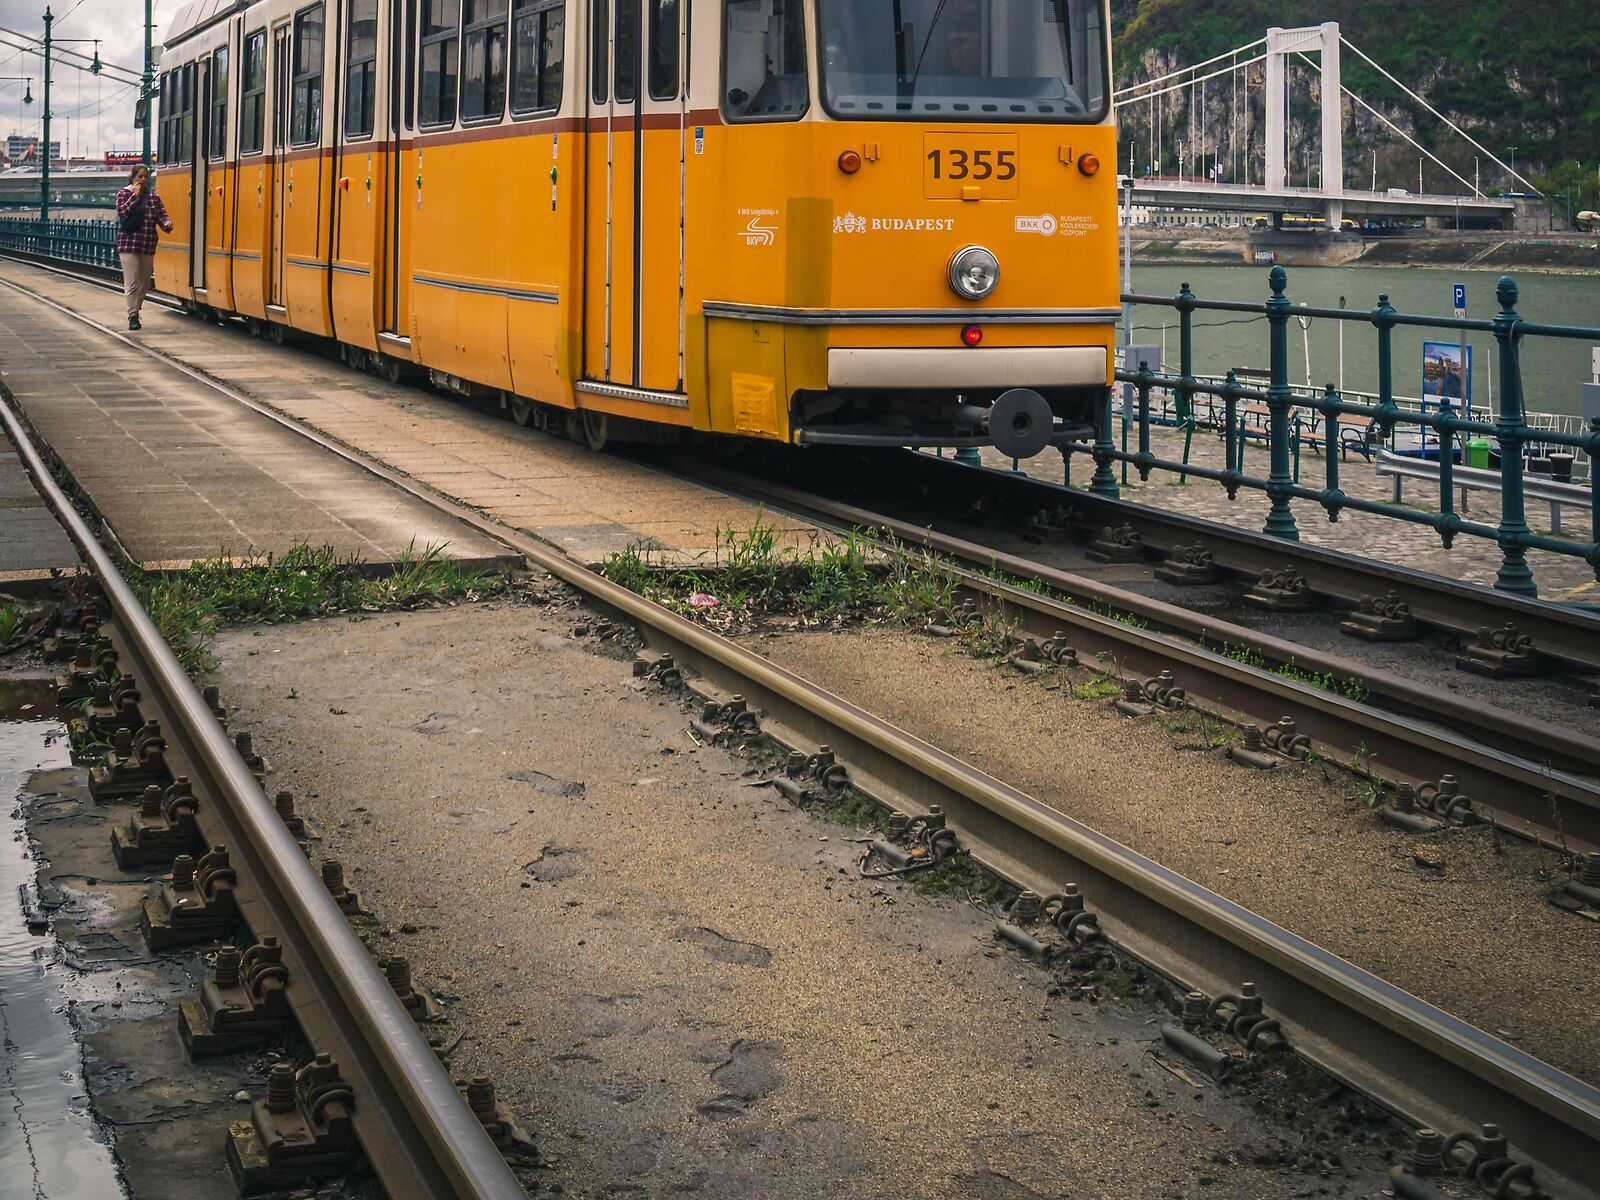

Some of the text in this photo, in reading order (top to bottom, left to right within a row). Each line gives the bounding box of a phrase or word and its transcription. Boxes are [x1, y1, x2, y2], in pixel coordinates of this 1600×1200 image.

[927, 149, 1016, 180] 1355
[871, 218, 955, 230] BUDAPEST
[1456, 288, 1463, 304] P
